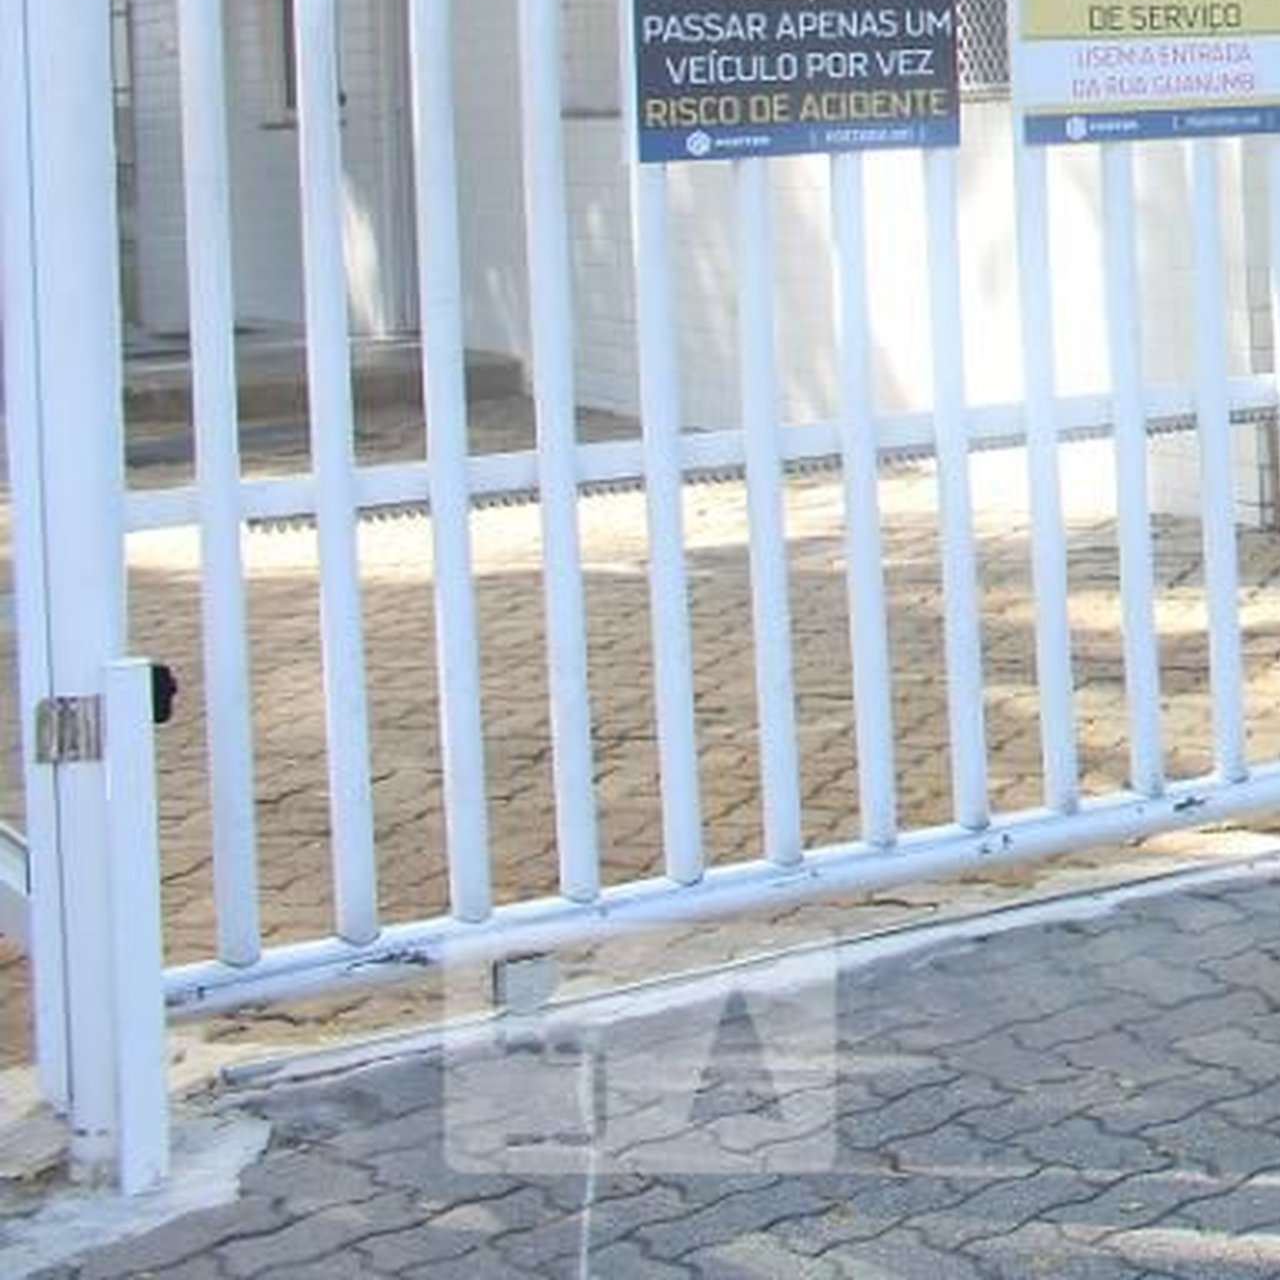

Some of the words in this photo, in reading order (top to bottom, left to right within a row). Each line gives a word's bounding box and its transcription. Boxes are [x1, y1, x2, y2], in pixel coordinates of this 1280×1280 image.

[643, 13, 766, 45] PASSAR
[775, 10, 898, 42] APENAS
[905, 9, 951, 38] UM
[1089, 4, 1124, 32] DE
[665, 48, 799, 85] VEÍCULO
[806, 51, 869, 80] POR
[875, 49, 935, 77] VEZ
[644, 96, 740, 128] RISCO
[751, 93, 791, 124] DE
[800, 89, 949, 123] ACIDENTE
